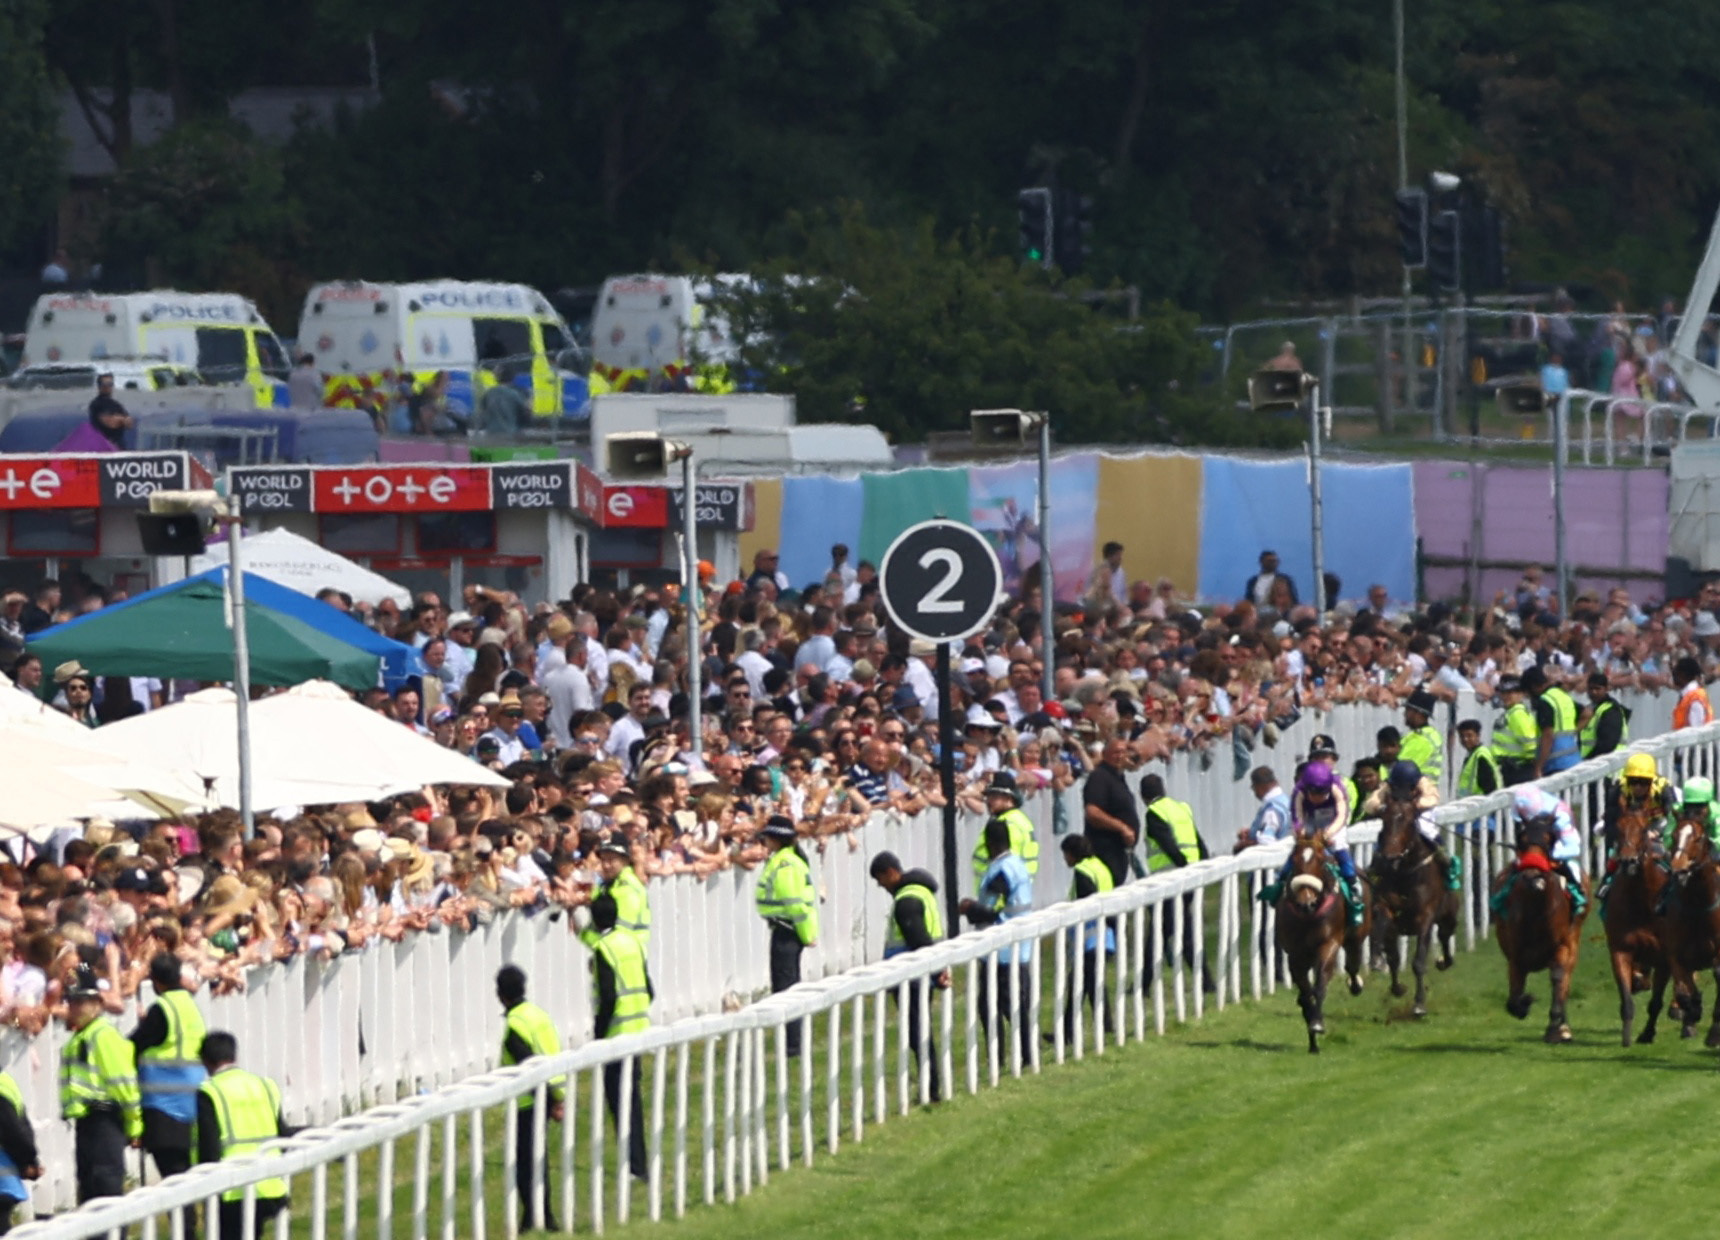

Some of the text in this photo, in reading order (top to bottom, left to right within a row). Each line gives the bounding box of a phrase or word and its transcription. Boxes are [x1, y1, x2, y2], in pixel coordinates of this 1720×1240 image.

[421, 290, 525, 308] POLICE
[153, 302, 236, 320] POLICE
[106, 461, 178, 479] WORLD
[239, 474, 303, 490] WORLD
[500, 475, 562, 490] WORLD
[244, 492, 293, 508] POOL
[507, 492, 554, 507] POOL
[680, 508, 725, 521] OOL
[917, 547, 965, 613] 2
